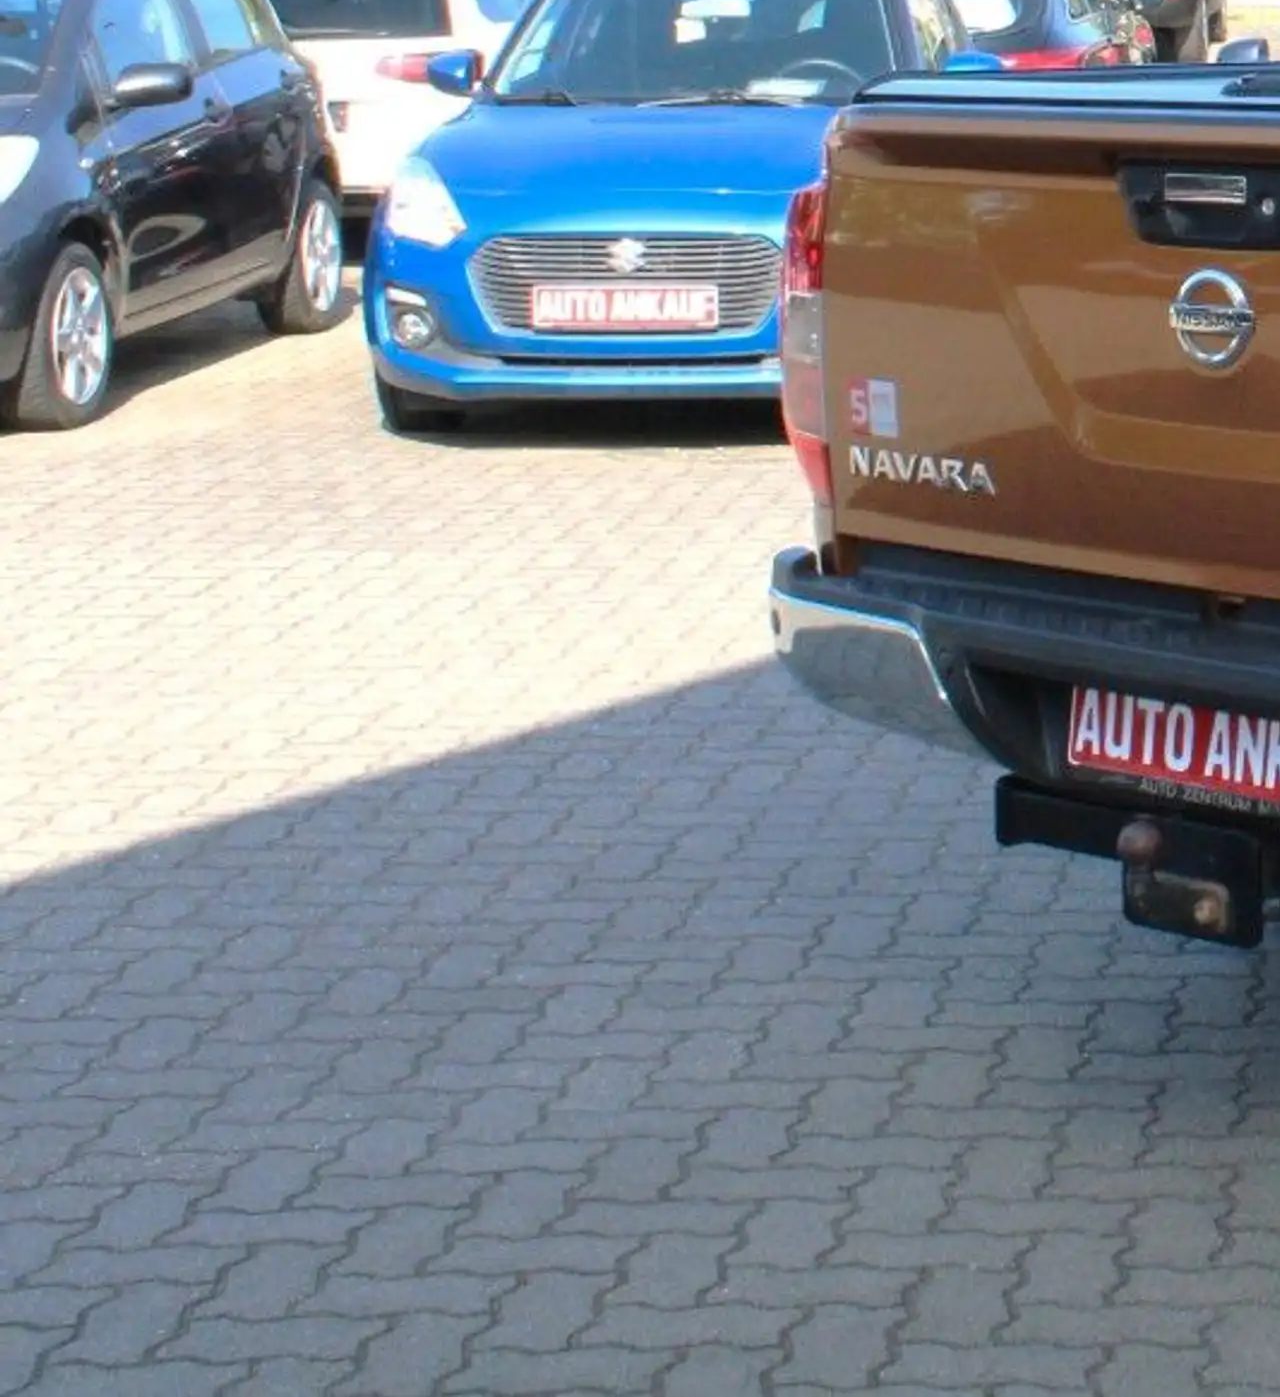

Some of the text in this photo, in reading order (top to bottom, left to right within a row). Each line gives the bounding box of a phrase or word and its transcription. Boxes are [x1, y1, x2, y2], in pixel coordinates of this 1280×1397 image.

[538, 289, 717, 322] AUTO ANKAUF
[849, 445, 996, 497] NAVARA
[1075, 687, 1195, 773] AUTO
